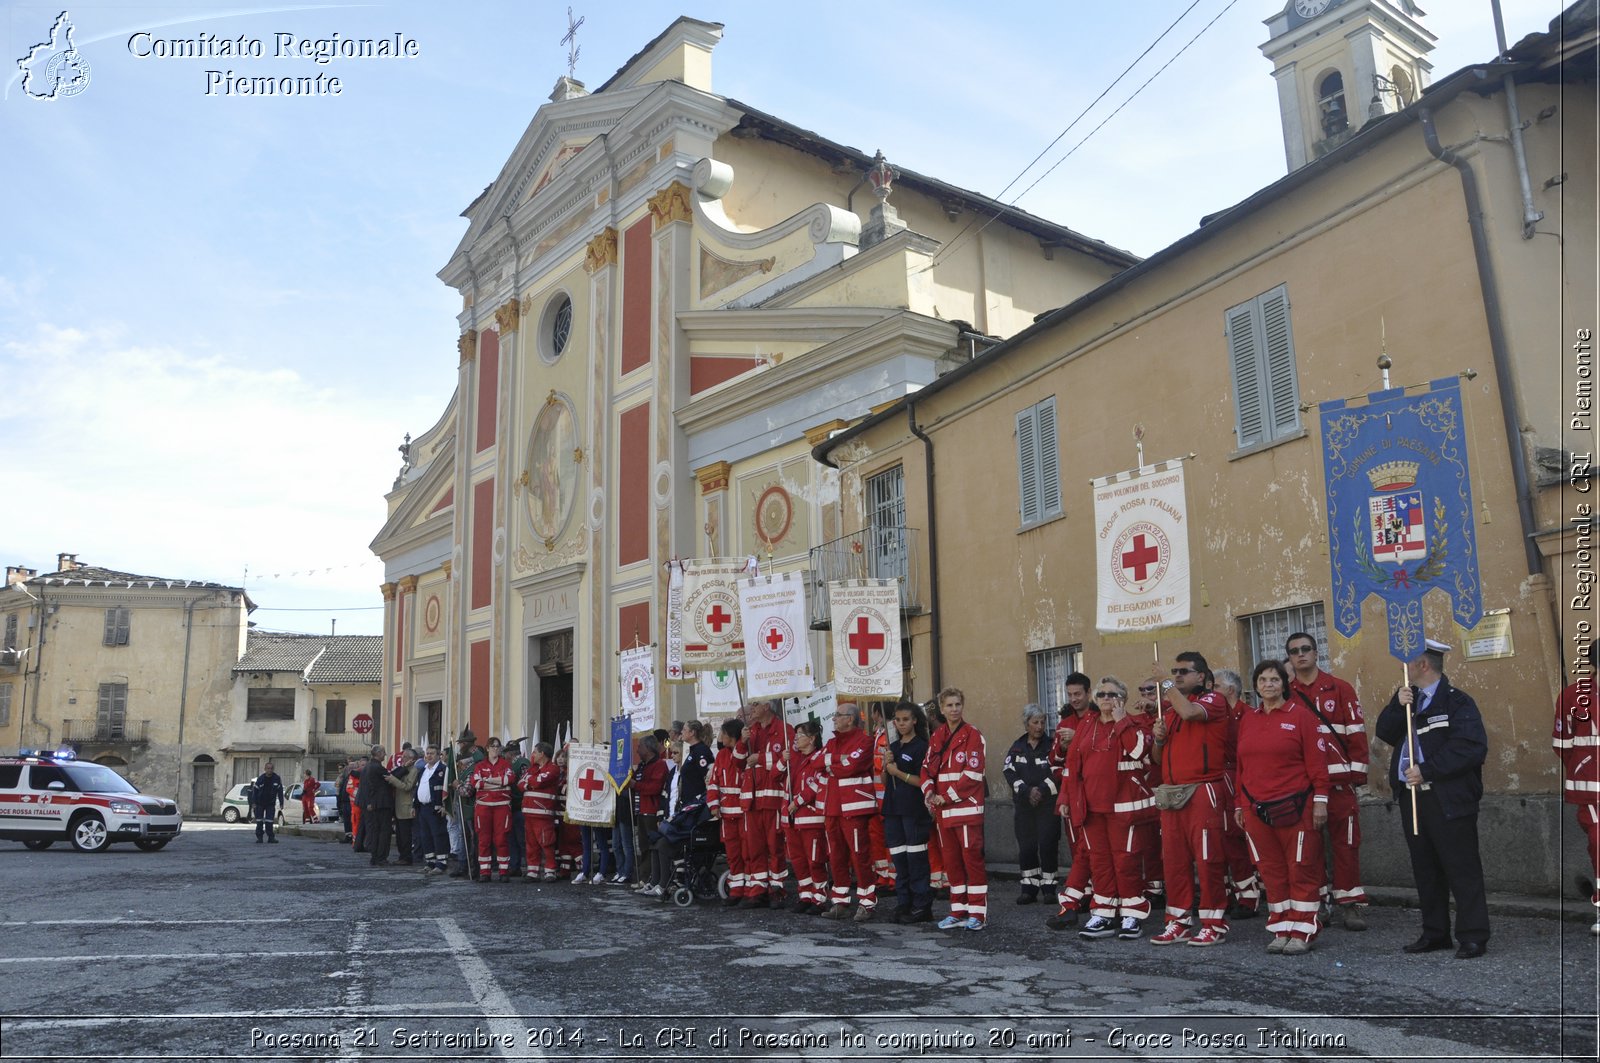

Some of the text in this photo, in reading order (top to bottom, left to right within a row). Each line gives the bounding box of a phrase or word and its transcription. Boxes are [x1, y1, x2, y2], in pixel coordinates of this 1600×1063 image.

[1346, 436, 1440, 478] COMUNE DI PAESANA
[1114, 484, 1140, 496] VOLONTARI
[1140, 482, 1150, 490] DEL
[1152, 475, 1180, 488] SOCCORSO
[1100, 498, 1182, 540] CROCE ROSSA ITALIANA
[1112, 540, 1128, 587] CONVENZIONE
[1121, 532, 1128, 540] DI
[1128, 524, 1152, 535] GINEVRA
[1152, 527, 1160, 536] 22
[1158, 534, 1168, 565] AGOSTO
[671, 588, 680, 616] ITALIANA
[684, 588, 702, 612] CROCE
[702, 580, 726, 591] ROSSA
[1107, 596, 1175, 614] DELEGAZIONE DI
[1117, 614, 1162, 628] PAESANA
[670, 641, 680, 662] CROCE
[755, 669, 794, 680] DELEGAZIONE
[844, 676, 882, 686] DELEGAZIONE
[848, 685, 882, 694] DRONERO
[354, 720, 372, 728] STOP
